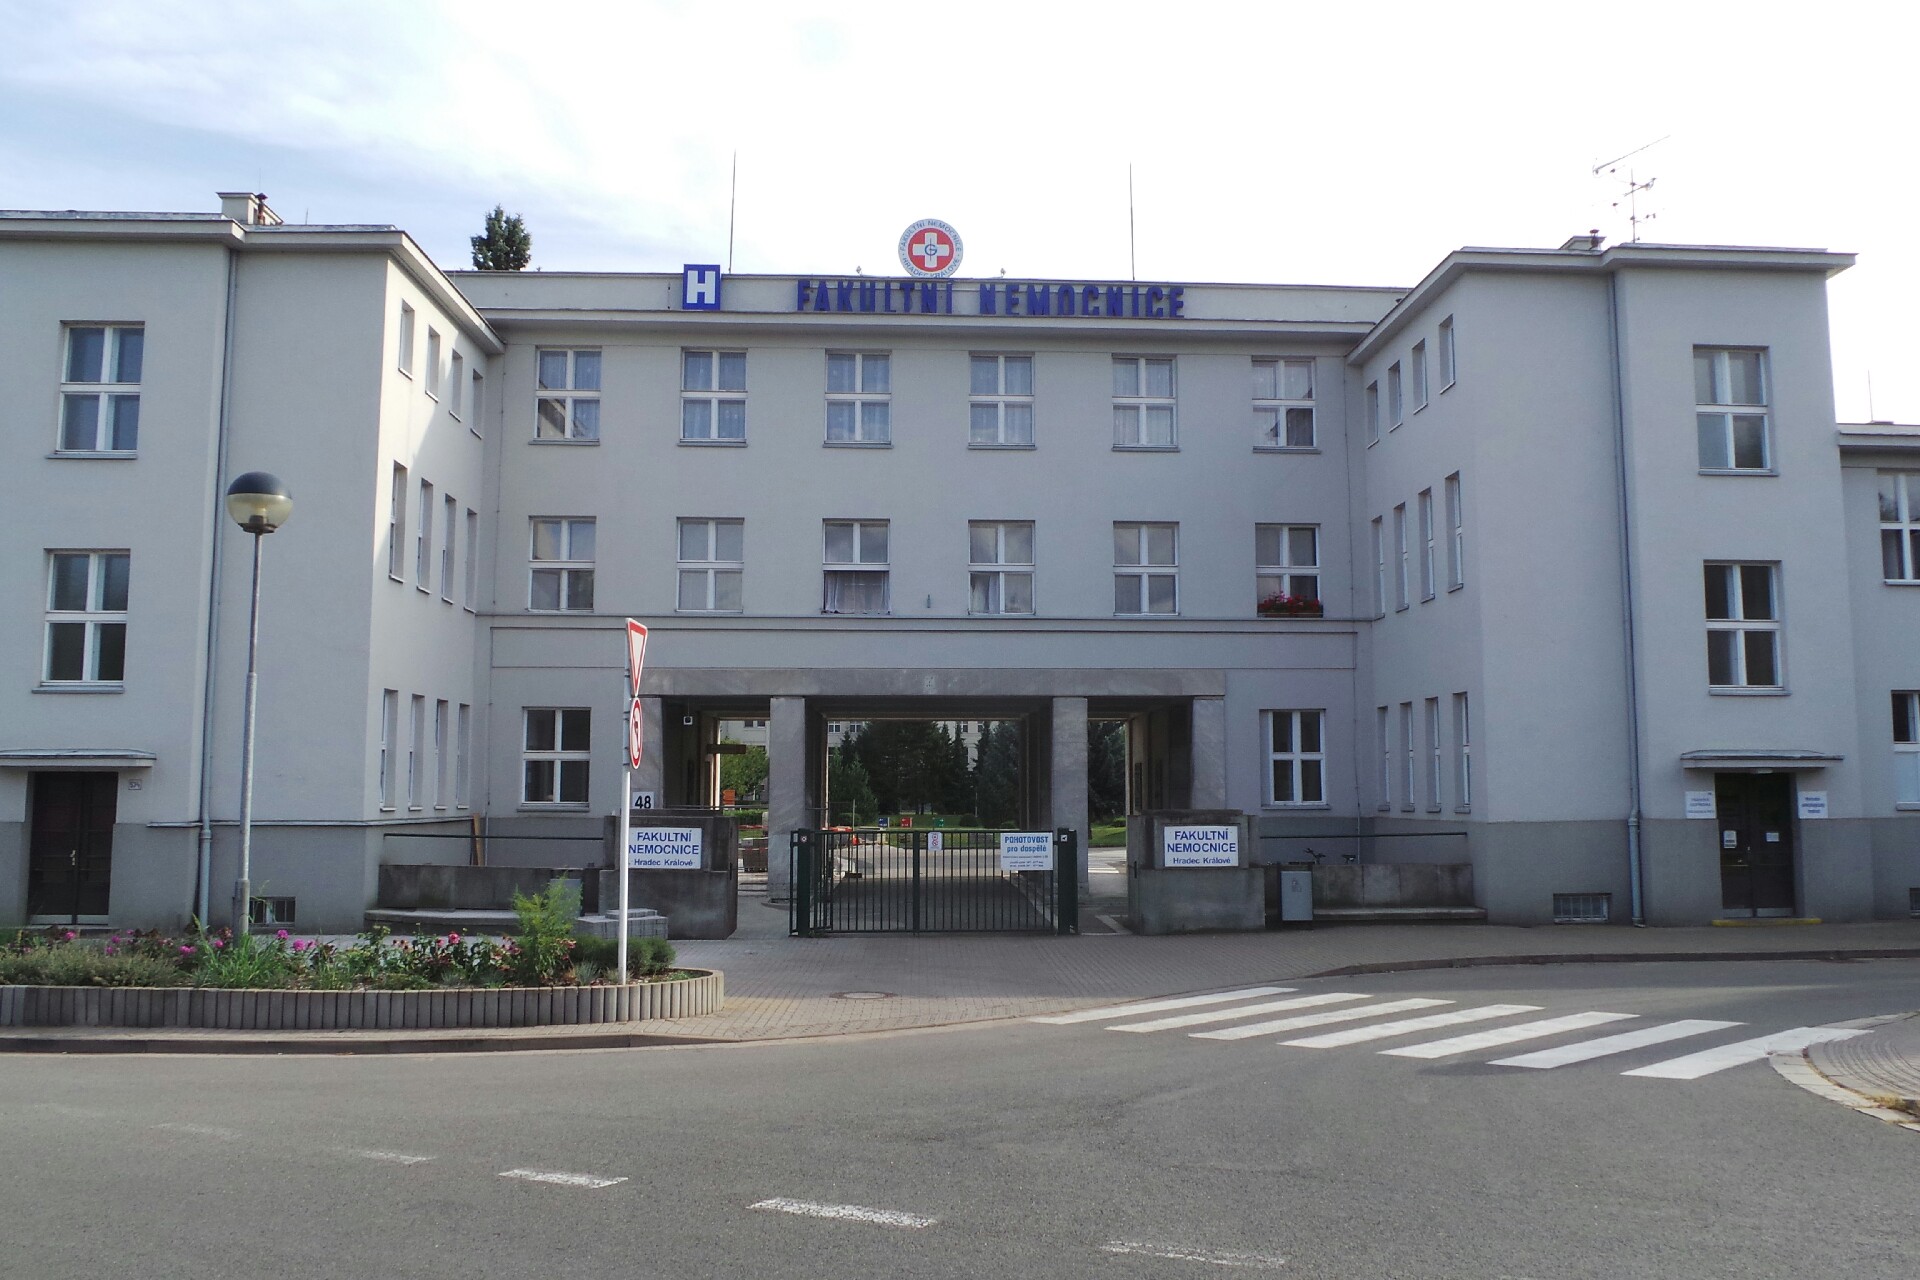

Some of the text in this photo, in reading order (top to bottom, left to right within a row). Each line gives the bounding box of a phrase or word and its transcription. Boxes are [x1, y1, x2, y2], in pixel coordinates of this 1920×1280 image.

[928, 220, 962, 252] NEMOCNICE
[687, 270, 717, 305] H
[979, 283, 1185, 319] NEMOCNICE
[634, 795, 652, 809] 48
[636, 830, 692, 842] FAKULTNÍ
[1174, 828, 1229, 840] FAKULTNÍ
[628, 844, 700, 855] NEMOCNICE
[1020, 845, 1046, 853] dospělé
[1167, 842, 1237, 853] NEMOCNICE
[1172, 856, 1231, 865] Hradec Králové
